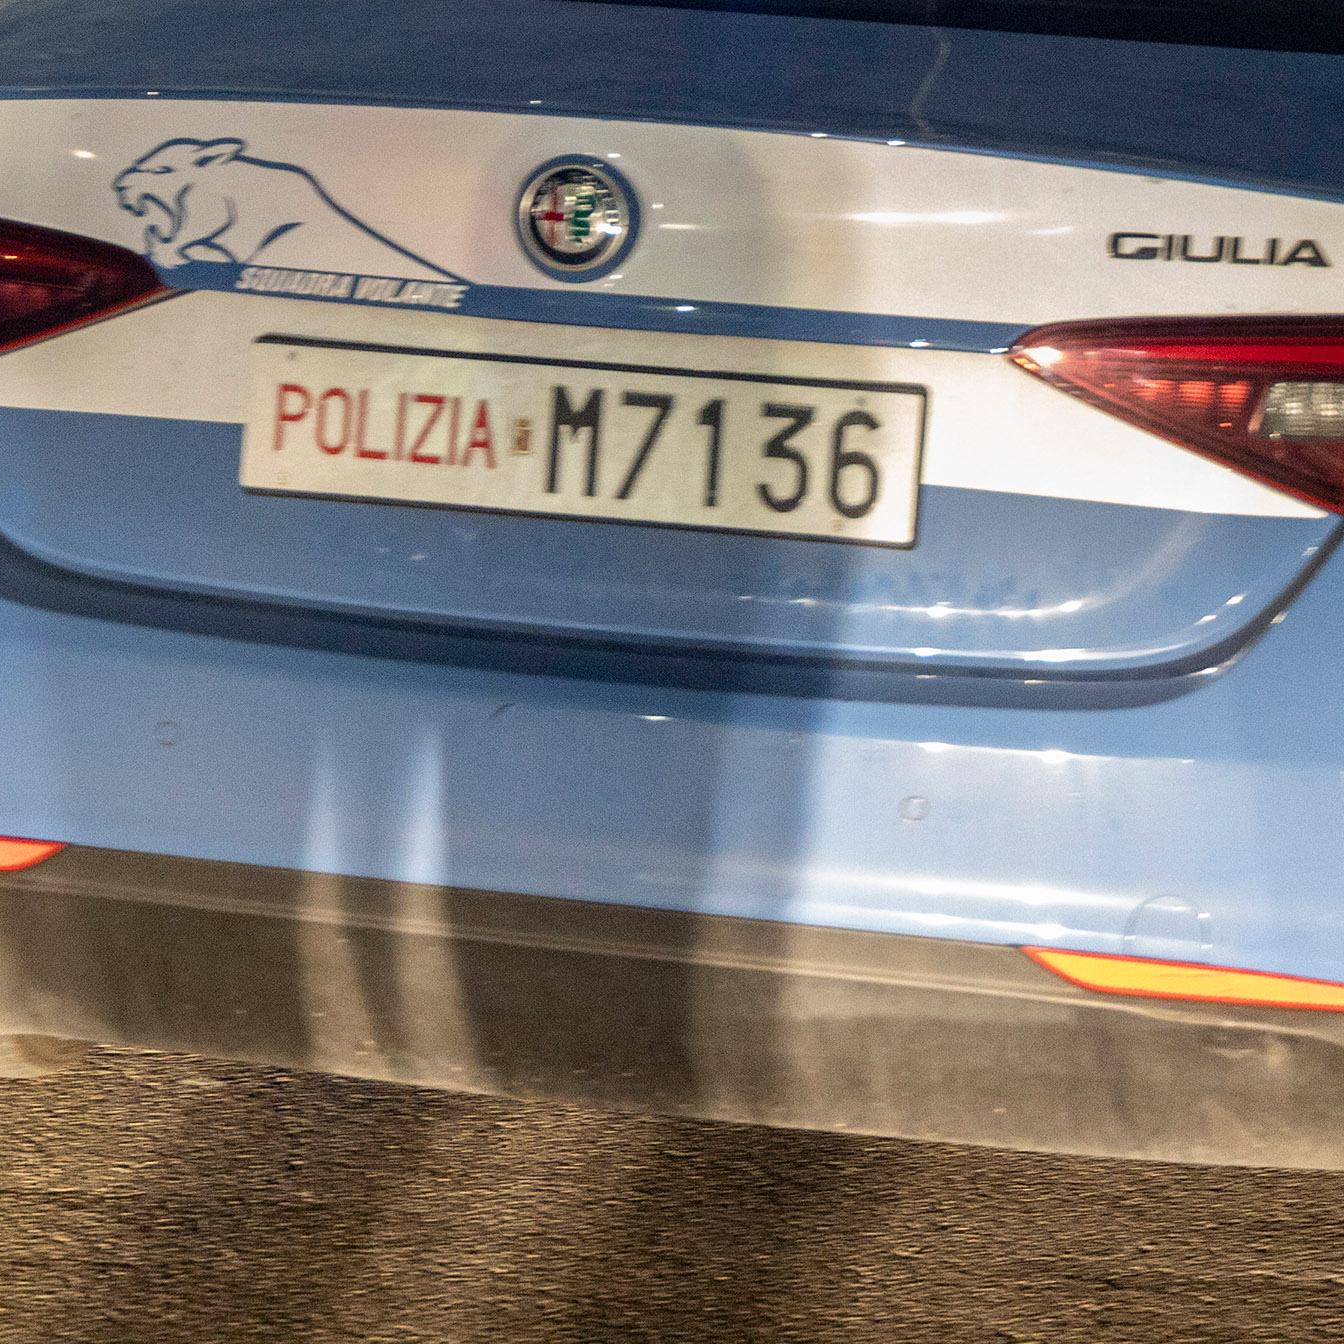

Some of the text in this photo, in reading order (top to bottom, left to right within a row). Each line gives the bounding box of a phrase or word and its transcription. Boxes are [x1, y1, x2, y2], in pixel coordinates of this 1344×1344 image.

[1107, 231, 1332, 268] GIULIA
[272, 383, 880, 519] POLIZIA M7136
